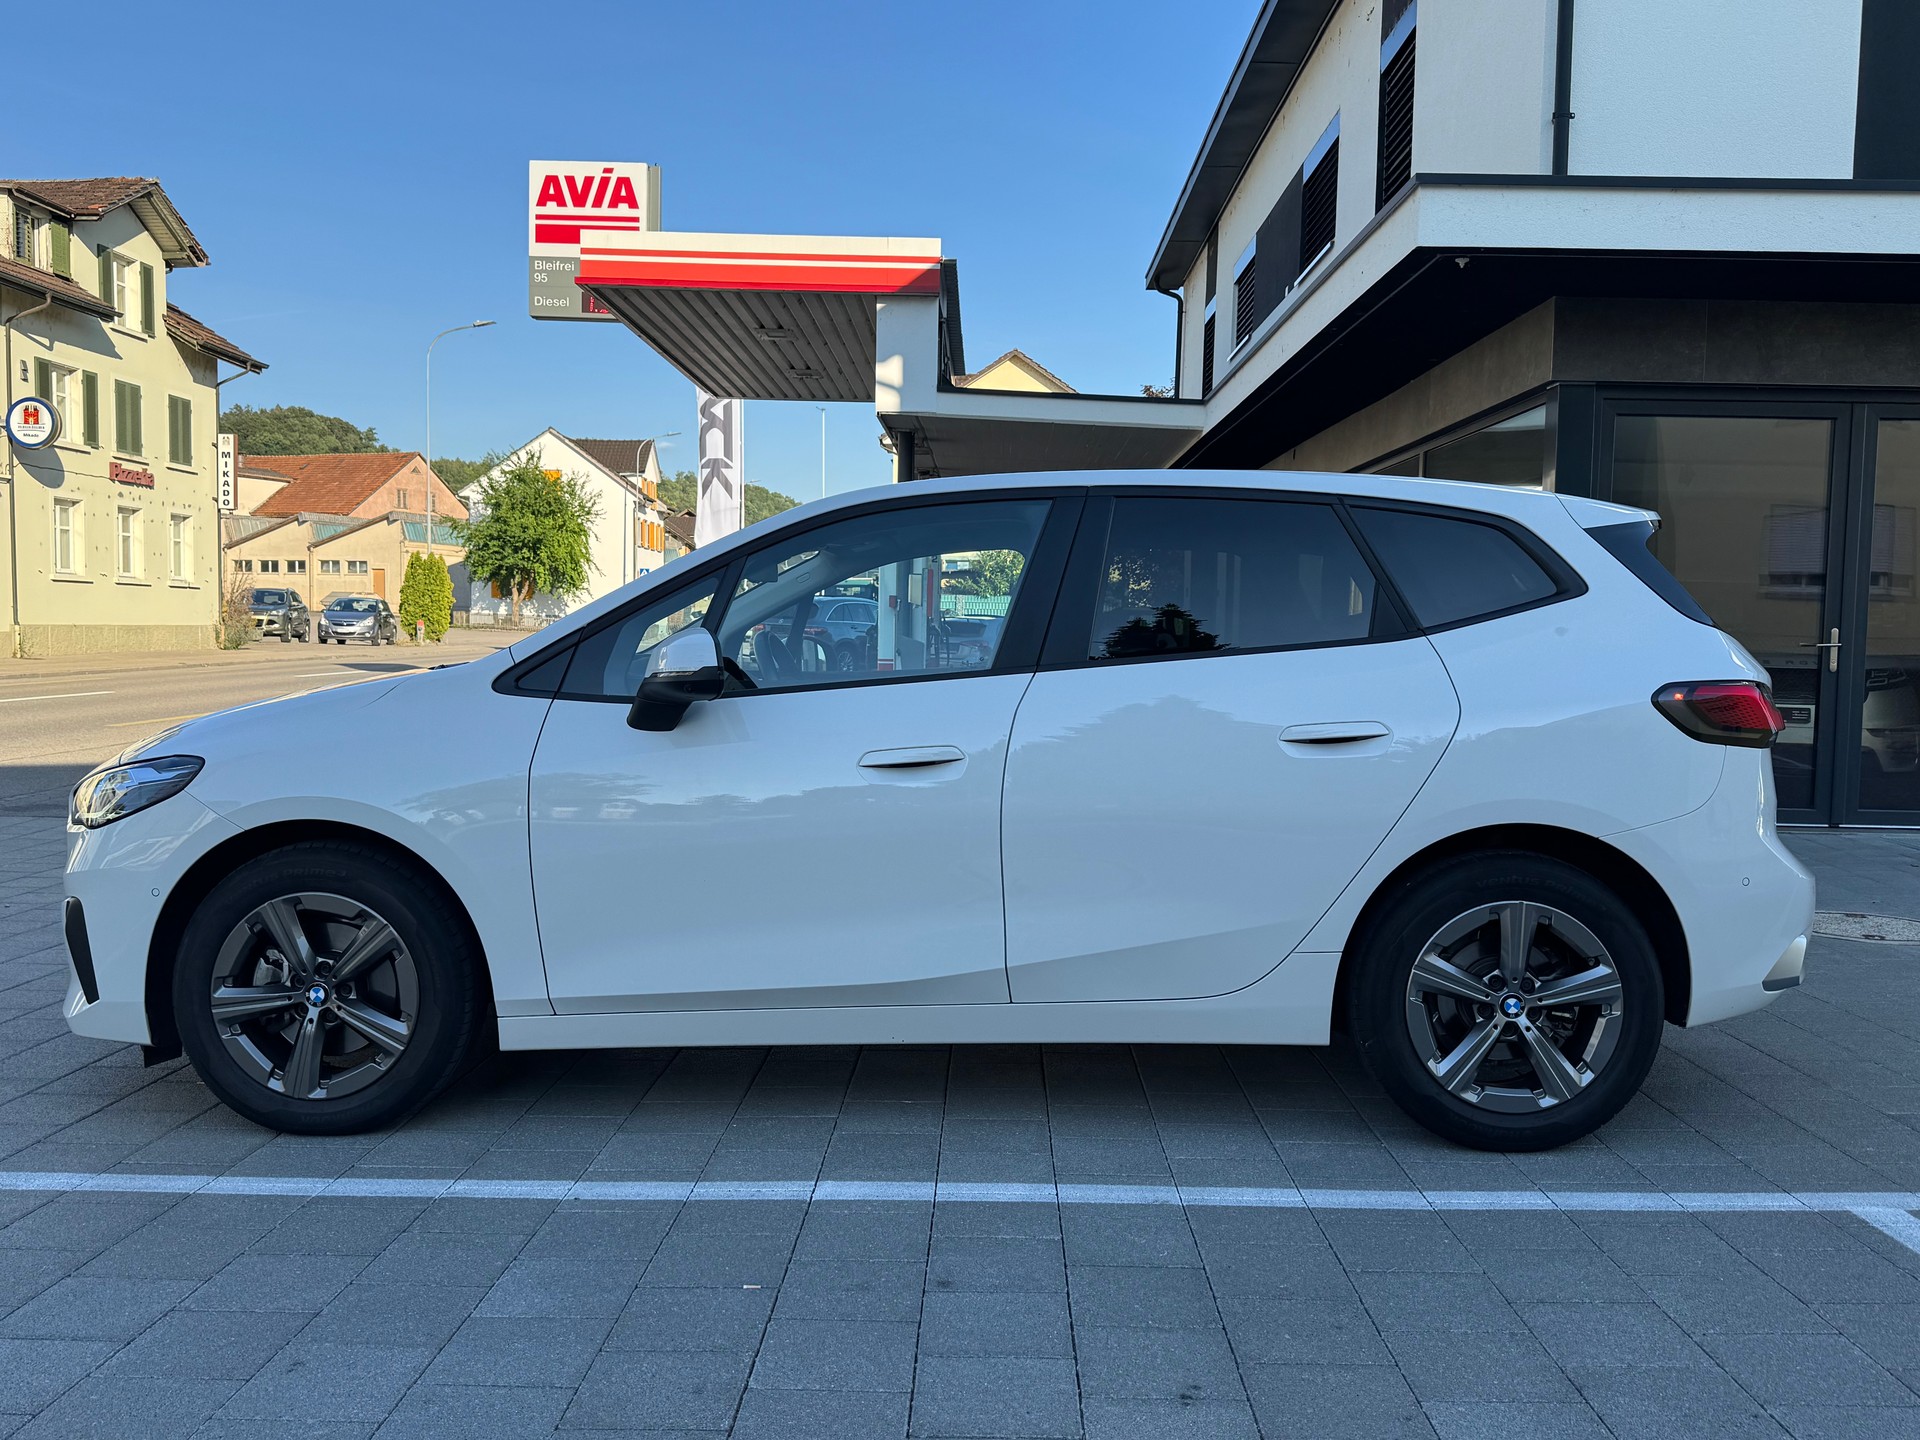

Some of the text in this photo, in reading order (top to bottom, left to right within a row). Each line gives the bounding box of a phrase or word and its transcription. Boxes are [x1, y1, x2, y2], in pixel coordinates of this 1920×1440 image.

[534, 260, 575, 271] Bleifrei
[534, 272, 548, 283] 95
[534, 296, 570, 307] Diesel
[221, 451, 231, 506] MIKADO
